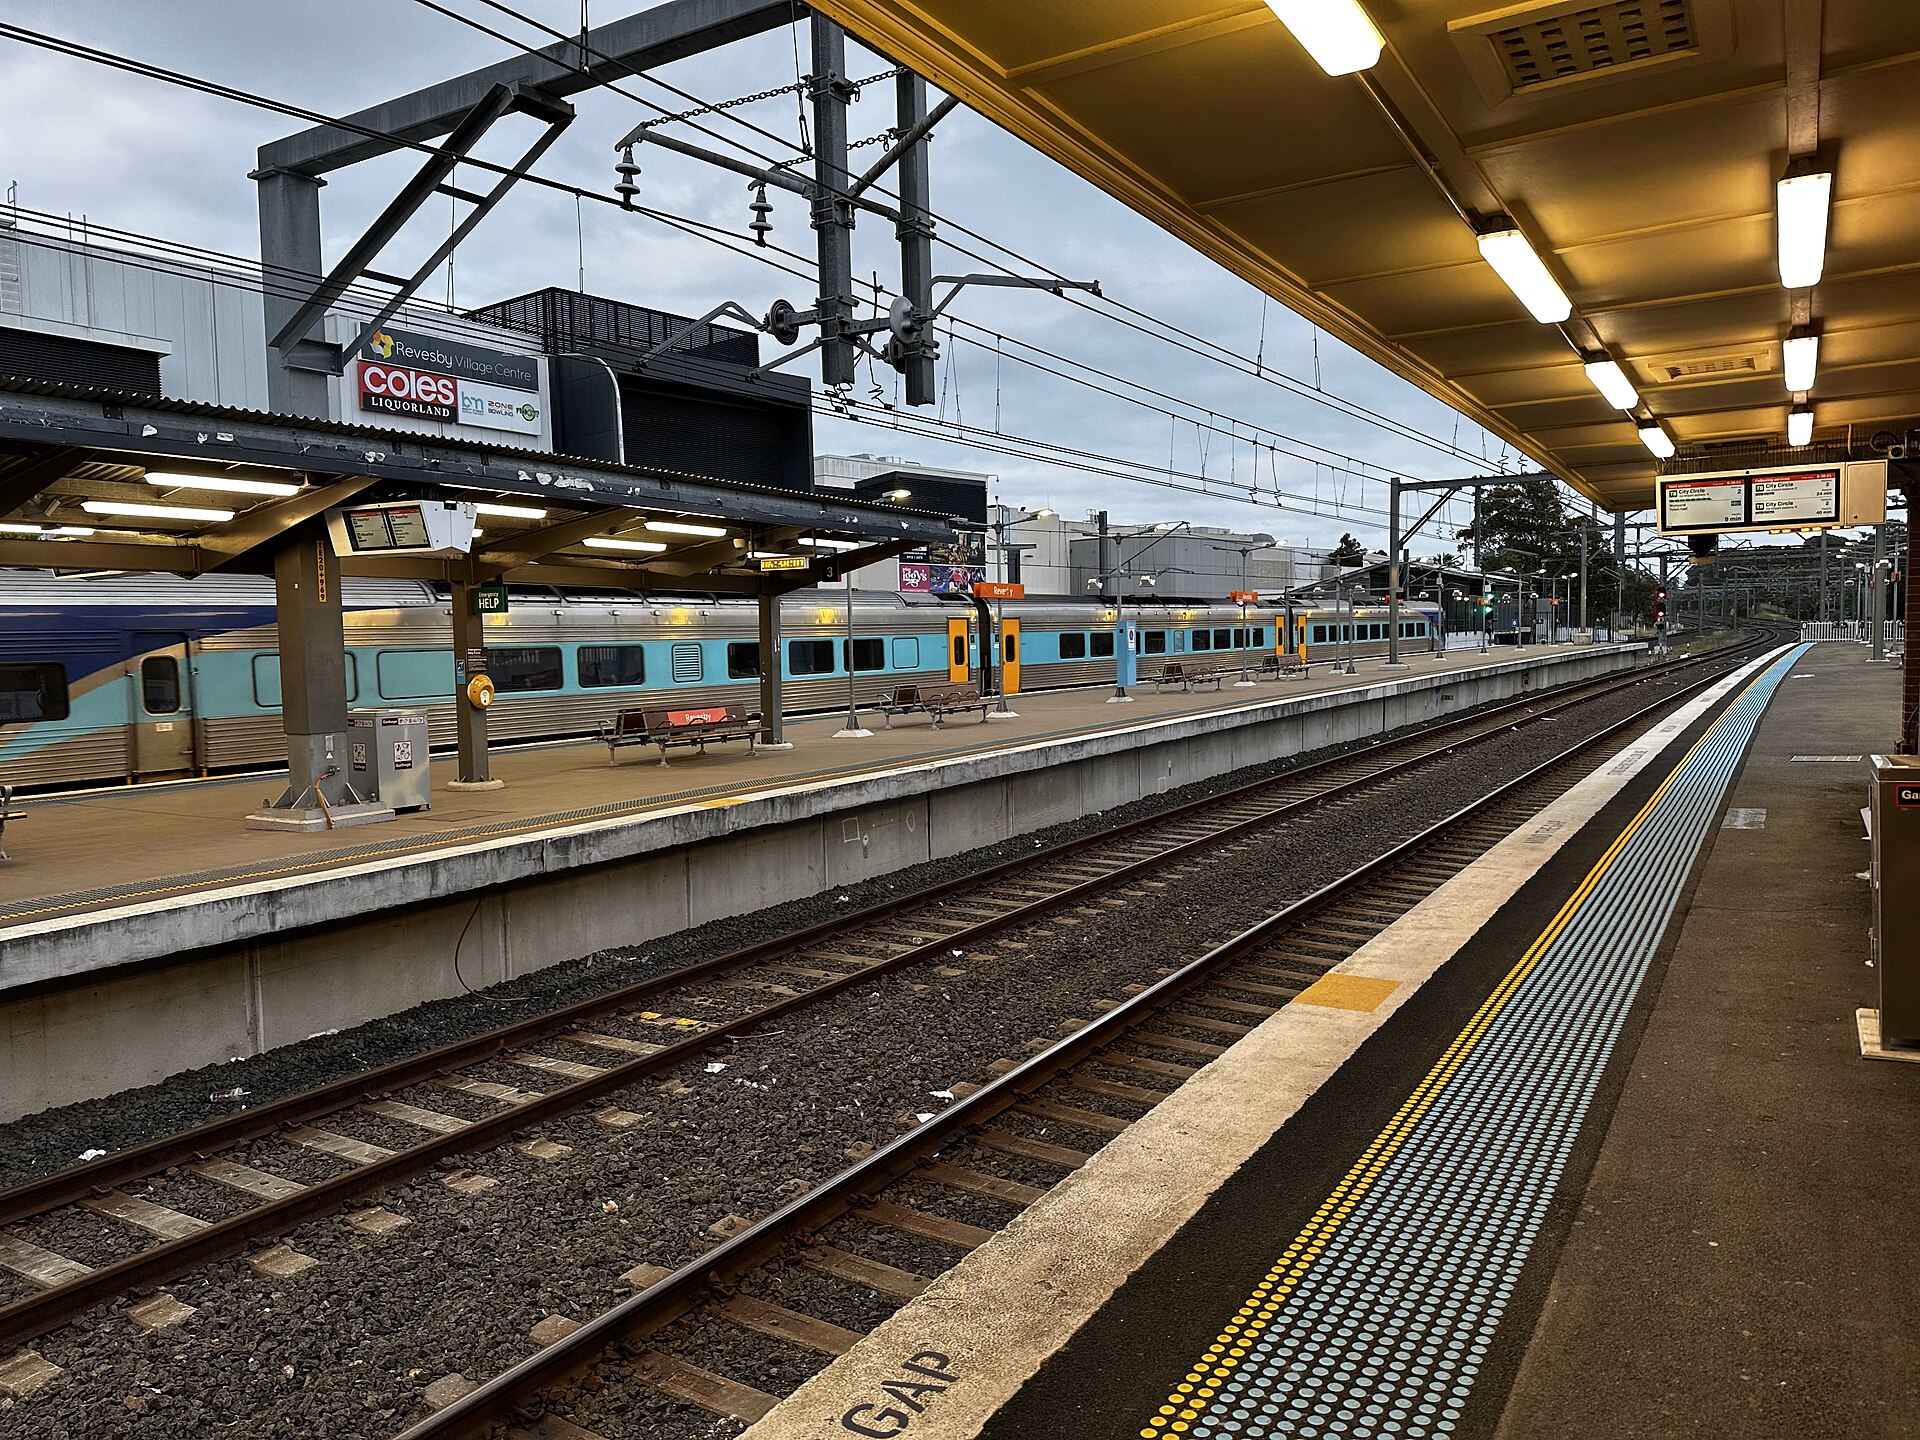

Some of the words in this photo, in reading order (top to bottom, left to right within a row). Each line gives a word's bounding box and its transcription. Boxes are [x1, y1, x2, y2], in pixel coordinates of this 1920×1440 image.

[396, 342, 453, 368] Revesby
[455, 357, 493, 375] Village
[494, 364, 532, 381] Centre
[363, 366, 454, 405] coles
[371, 396, 450, 417] LIQUORLAND
[487, 400, 513, 411] ZONE
[487, 408, 514, 417] BOWLING
[317, 541, 325, 601] TE20+969
[826, 566, 833, 577] 3
[993, 586, 1014, 597] Revey
[478, 598, 499, 609] HELP
[1901, 789, 1920, 800] Ga
[841, 1350, 961, 1439] GAP
